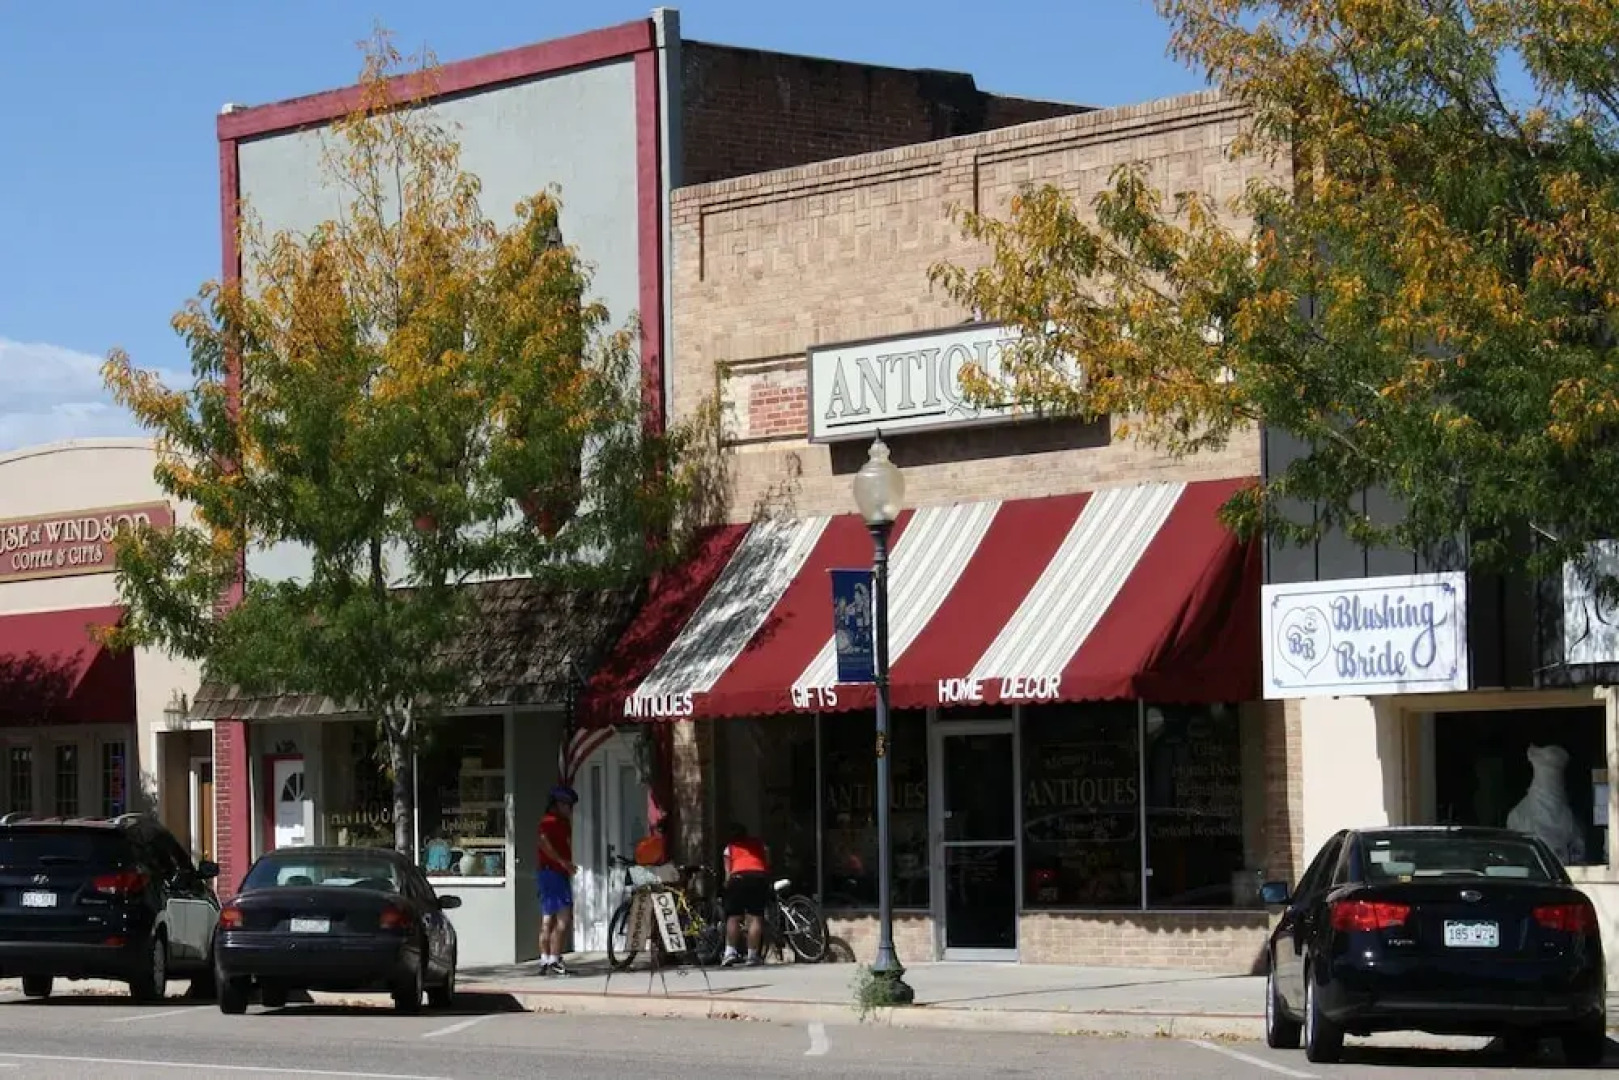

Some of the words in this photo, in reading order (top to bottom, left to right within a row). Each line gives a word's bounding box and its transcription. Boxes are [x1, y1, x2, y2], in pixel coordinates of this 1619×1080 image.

[825, 336, 1058, 419] ANTIQU
[69, 544, 103, 565] GIFTS
[1329, 594, 1447, 669] Blushing
[1332, 640, 1407, 678] Bride
[791, 685, 837, 708] GIFTS
[938, 679, 983, 703] HOME
[1000, 675, 1061, 699] DECOR
[827, 781, 925, 809] ANTIUES
[1027, 777, 1137, 807] ANTIQUES
[658, 894, 682, 949] OPEN
